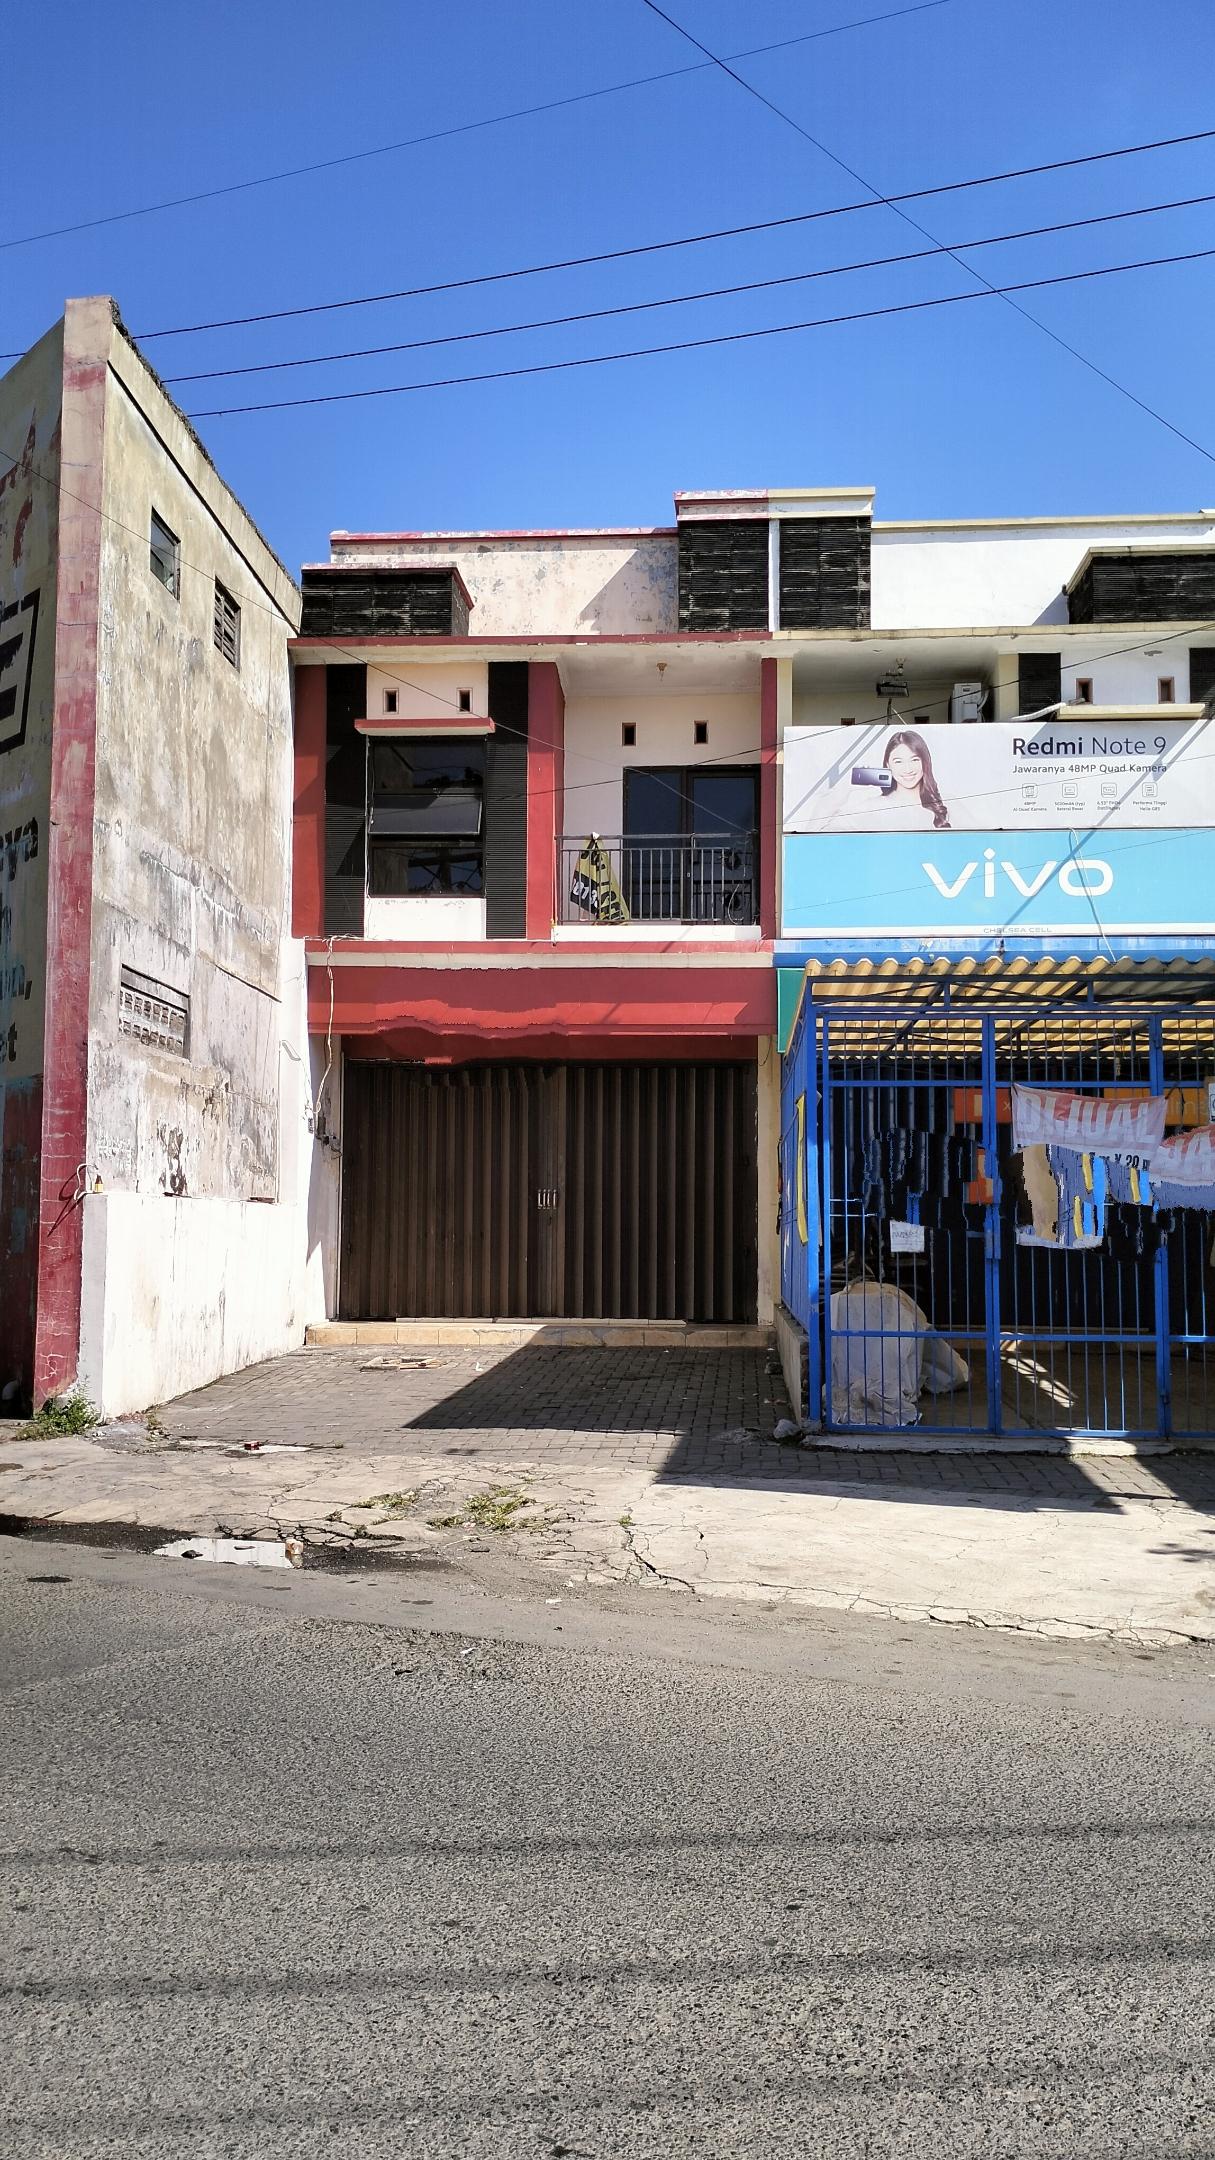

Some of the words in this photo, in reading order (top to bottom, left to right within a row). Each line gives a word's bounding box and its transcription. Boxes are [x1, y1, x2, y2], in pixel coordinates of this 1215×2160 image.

[1013, 737, 1083, 755] Redmi
[1092, 737, 1146, 755] Note
[1154, 736, 1167, 754] 9
[1012, 764, 1066, 775] Jawaranya
[1068, 764, 1097, 773] 48MP
[1099, 764, 1127, 774] Quad
[1129, 763, 1167, 773] Kamera
[921, 847, 1115, 898] vivo
[1016, 1092, 1158, 1144] DIJUAL
